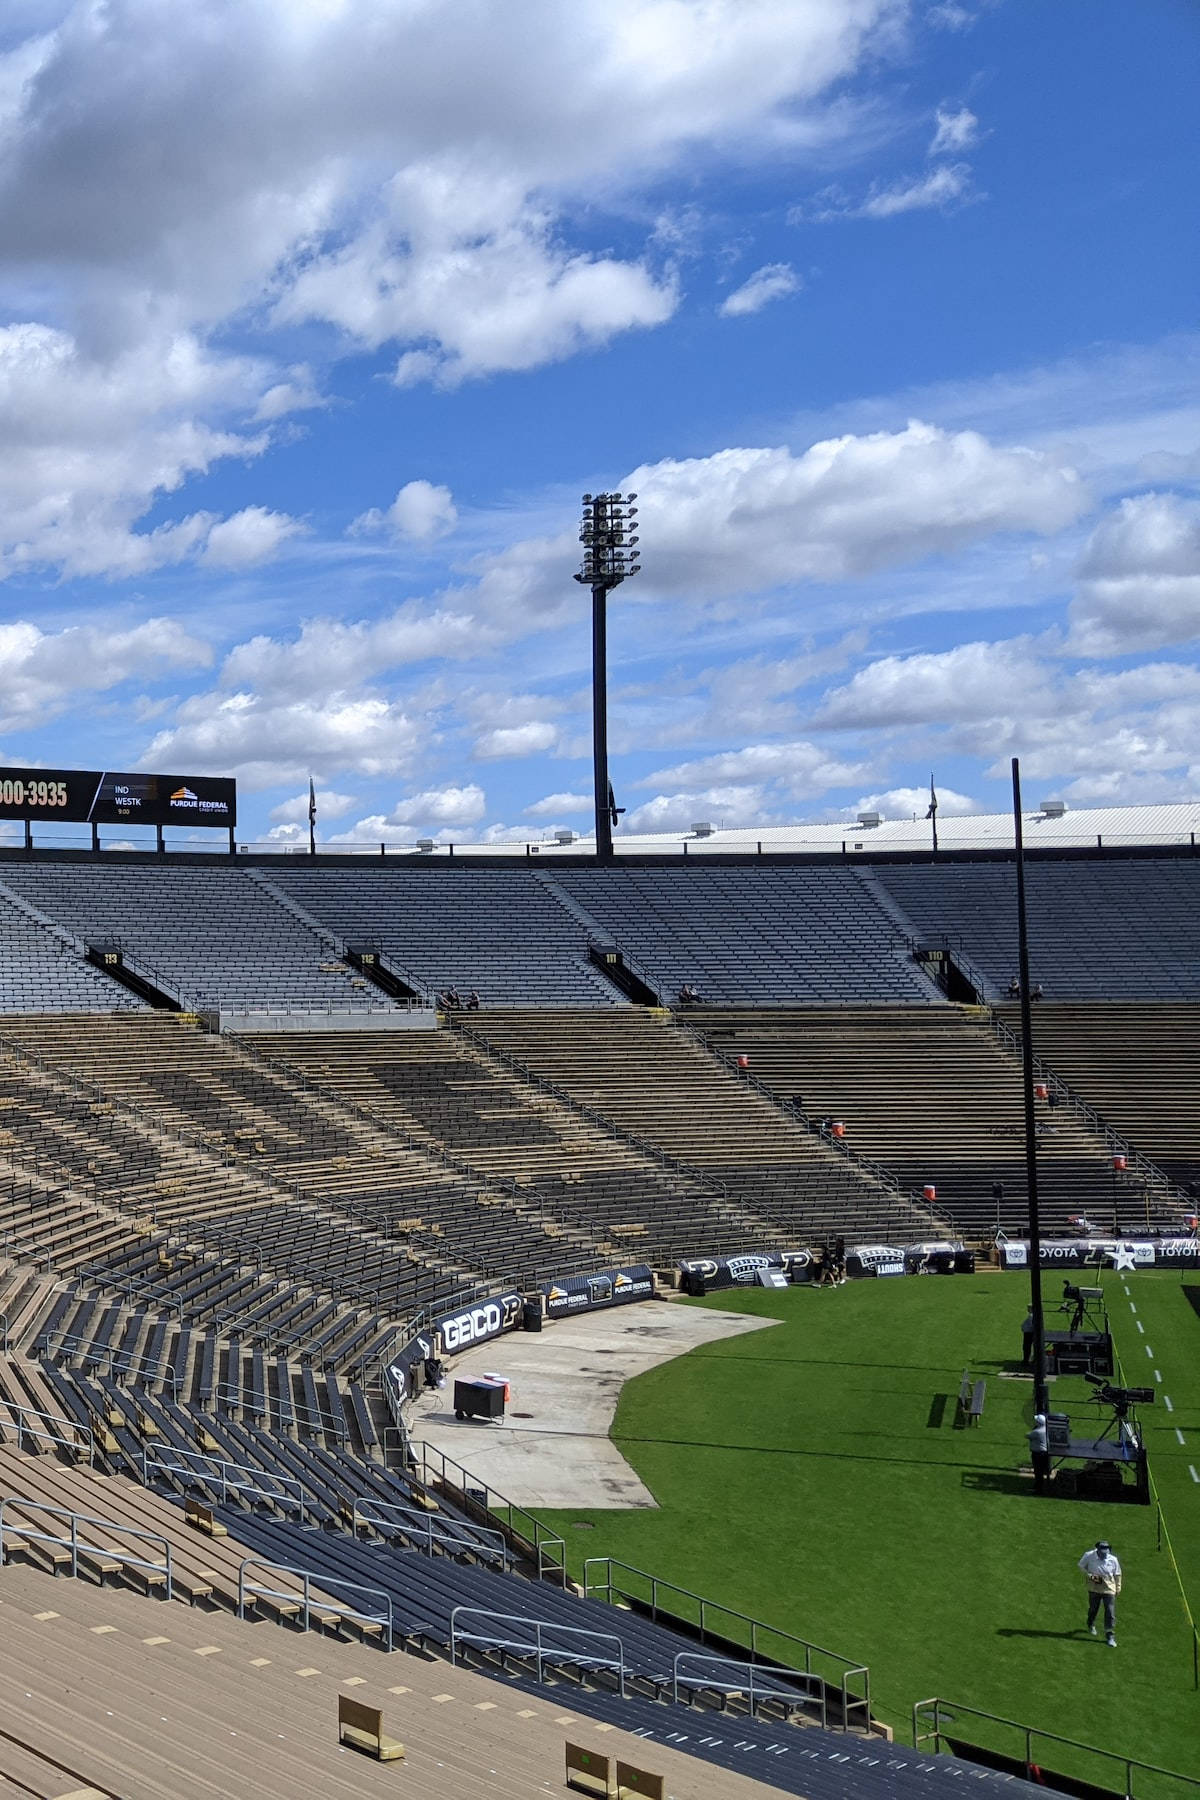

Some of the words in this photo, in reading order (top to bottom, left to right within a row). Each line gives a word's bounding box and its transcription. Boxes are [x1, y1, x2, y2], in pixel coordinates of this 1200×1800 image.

[115, 785, 130, 794] IND
[115, 797, 142, 806] WESTK
[170, 800, 198, 808] PURDUE
[198, 801, 229, 809] FEDERAL
[928, 951, 944, 961] 110
[1039, 1247, 1079, 1258] OYOTA
[500, 1295, 522, 1328] P
[442, 1304, 501, 1350] GEICO
